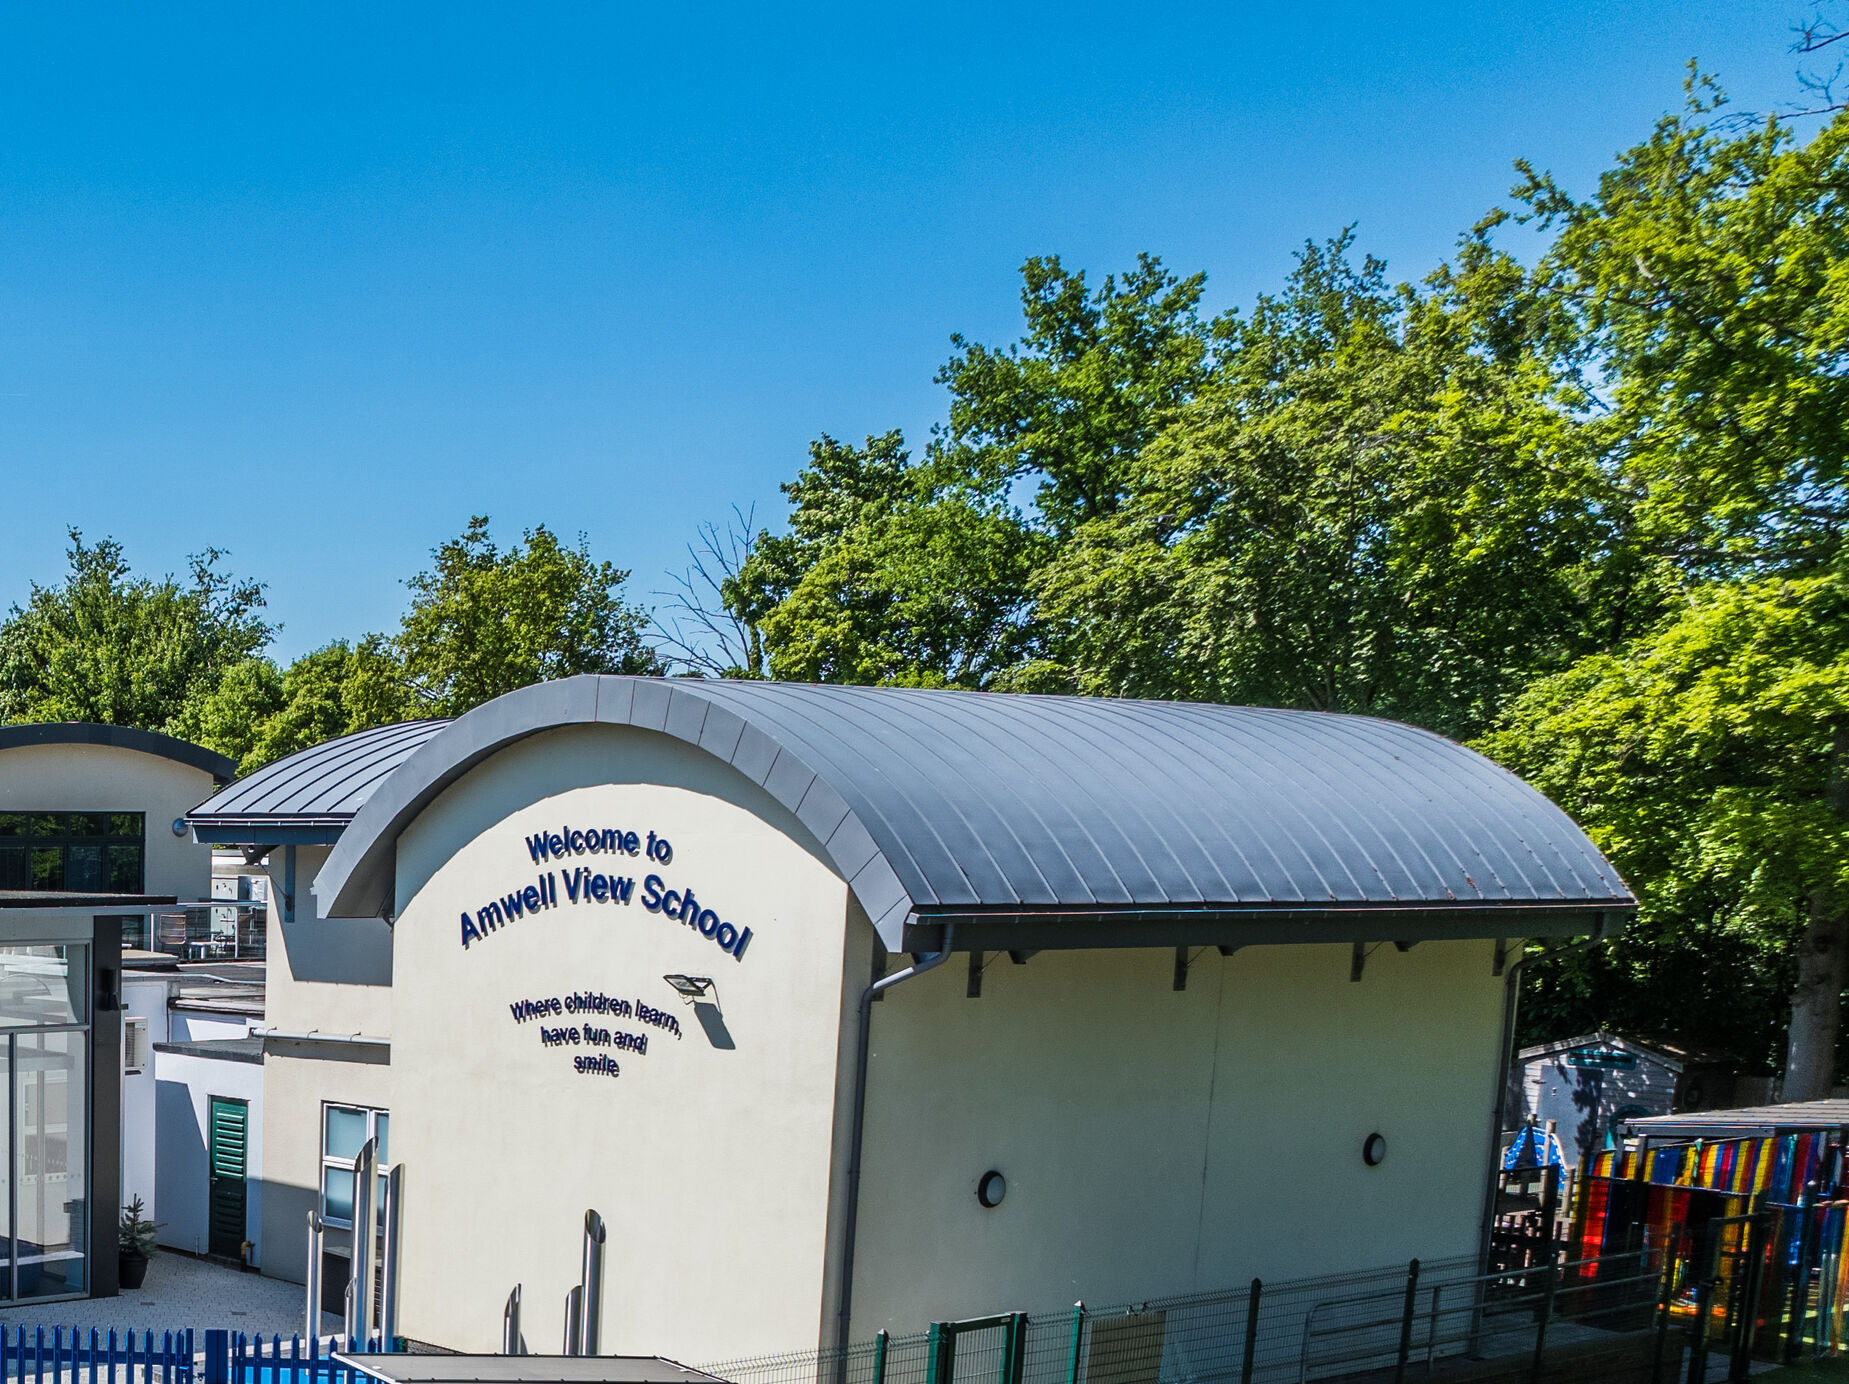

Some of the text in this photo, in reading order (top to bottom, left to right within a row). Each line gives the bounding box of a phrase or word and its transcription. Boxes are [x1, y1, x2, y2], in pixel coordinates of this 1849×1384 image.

[525, 826, 671, 863] Welcome to
[460, 867, 752, 958] Amwell View School
[510, 991, 682, 1040] Where children learn,
[540, 1023, 646, 1052] have fun and
[574, 1053, 619, 1075] smile
